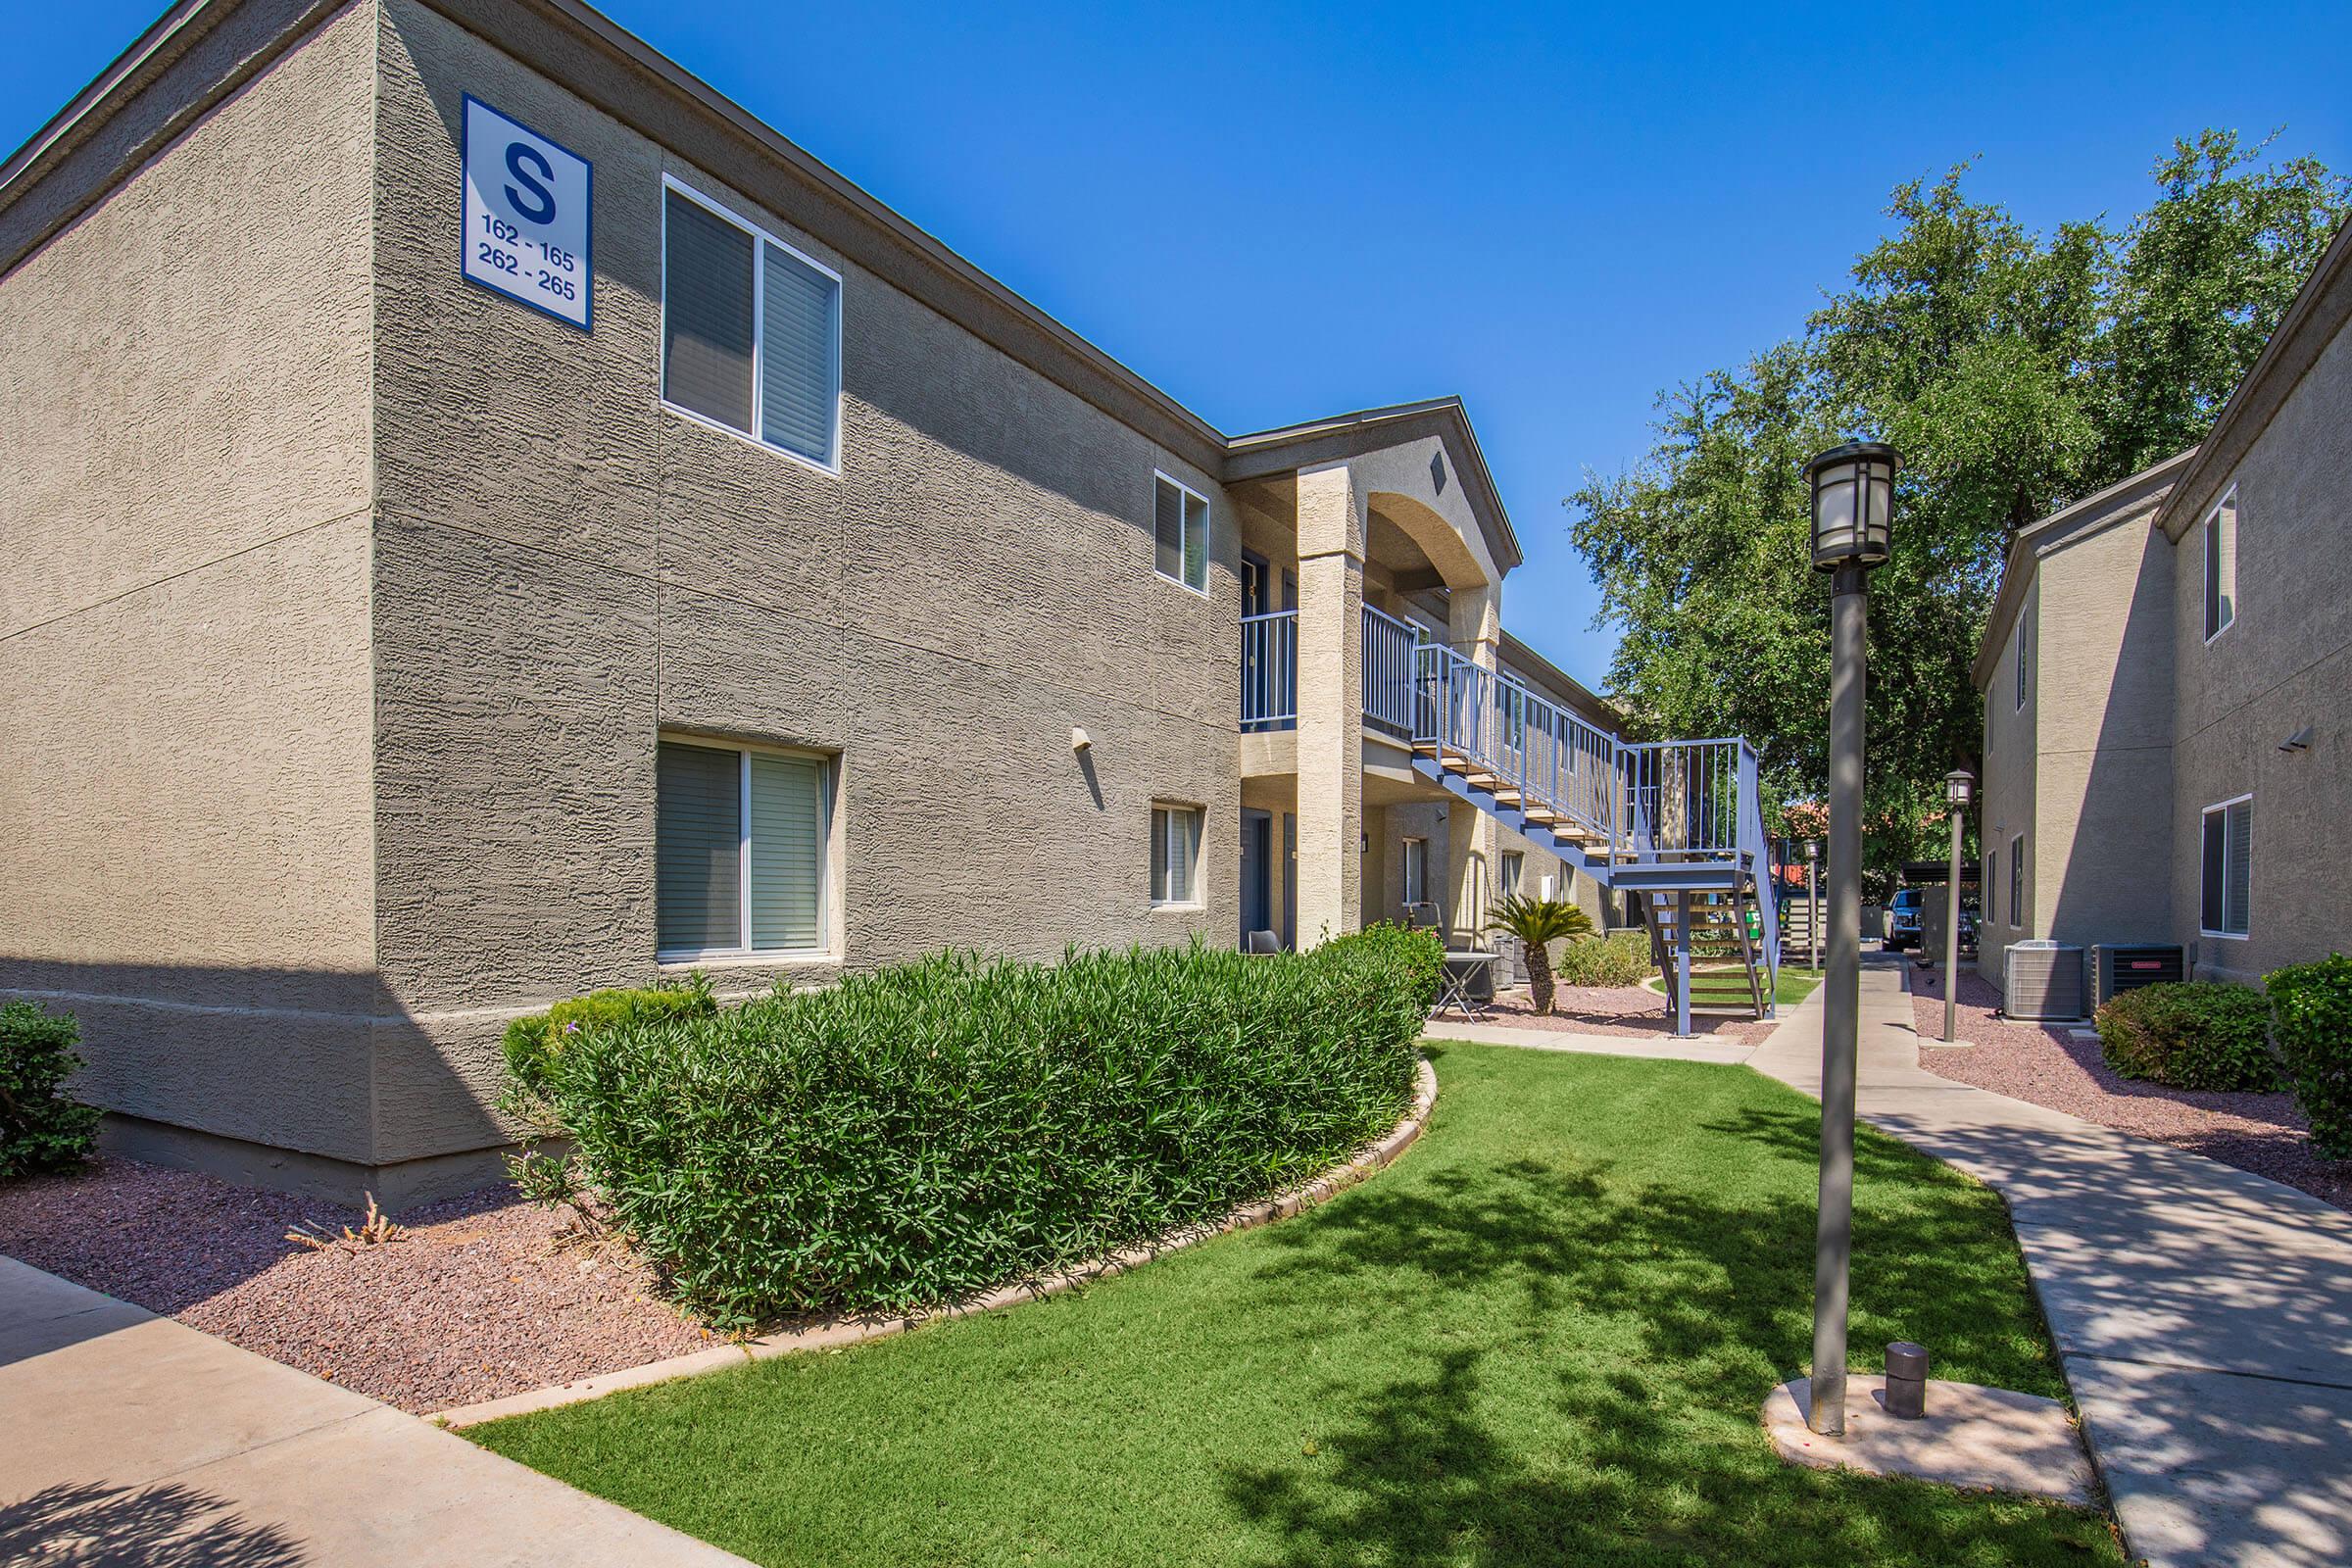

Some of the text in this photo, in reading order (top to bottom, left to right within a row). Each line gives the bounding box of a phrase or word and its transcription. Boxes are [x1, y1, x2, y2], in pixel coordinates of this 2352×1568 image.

[504, 142, 556, 224] S
[478, 242, 518, 275] 262
[538, 270, 575, 301] 265
[481, 214, 518, 247] 162
[539, 242, 574, 272] 165
